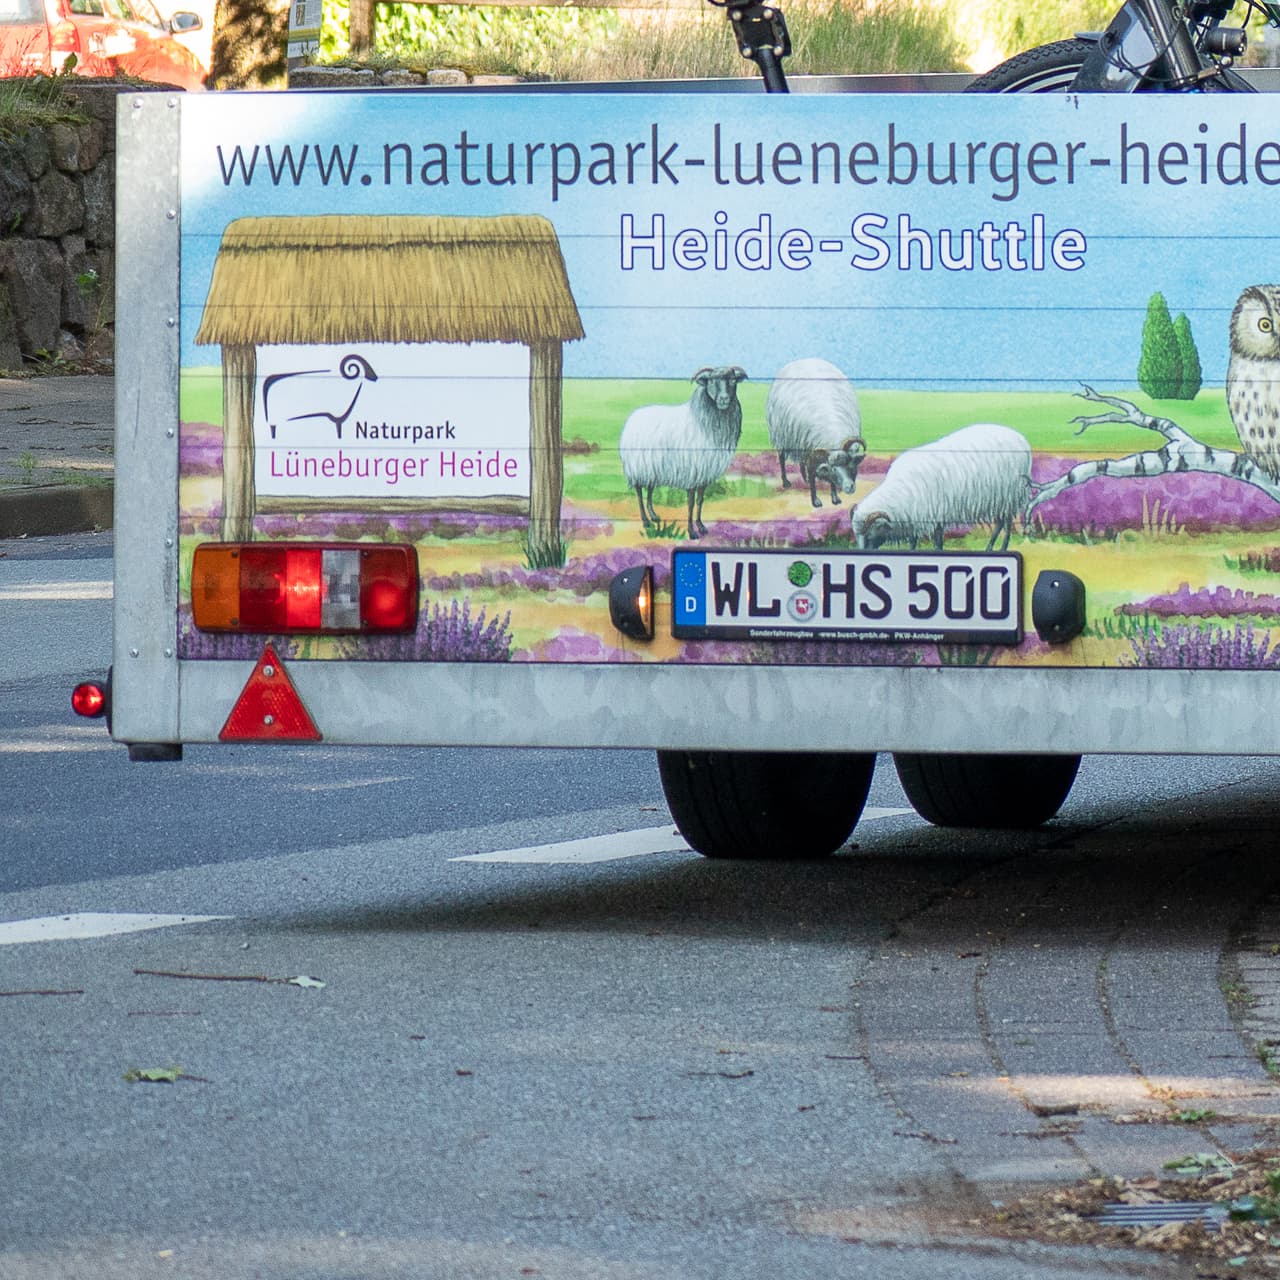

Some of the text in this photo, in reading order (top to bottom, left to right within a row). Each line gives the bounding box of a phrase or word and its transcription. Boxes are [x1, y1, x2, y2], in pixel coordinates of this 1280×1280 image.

[619, 212, 1088, 272] Heide-Shuttle
[355, 419, 456, 444] Naturpark
[269, 448, 518, 484] Lüneburger Heide
[685, 561, 1011, 621] D WL HS 500
